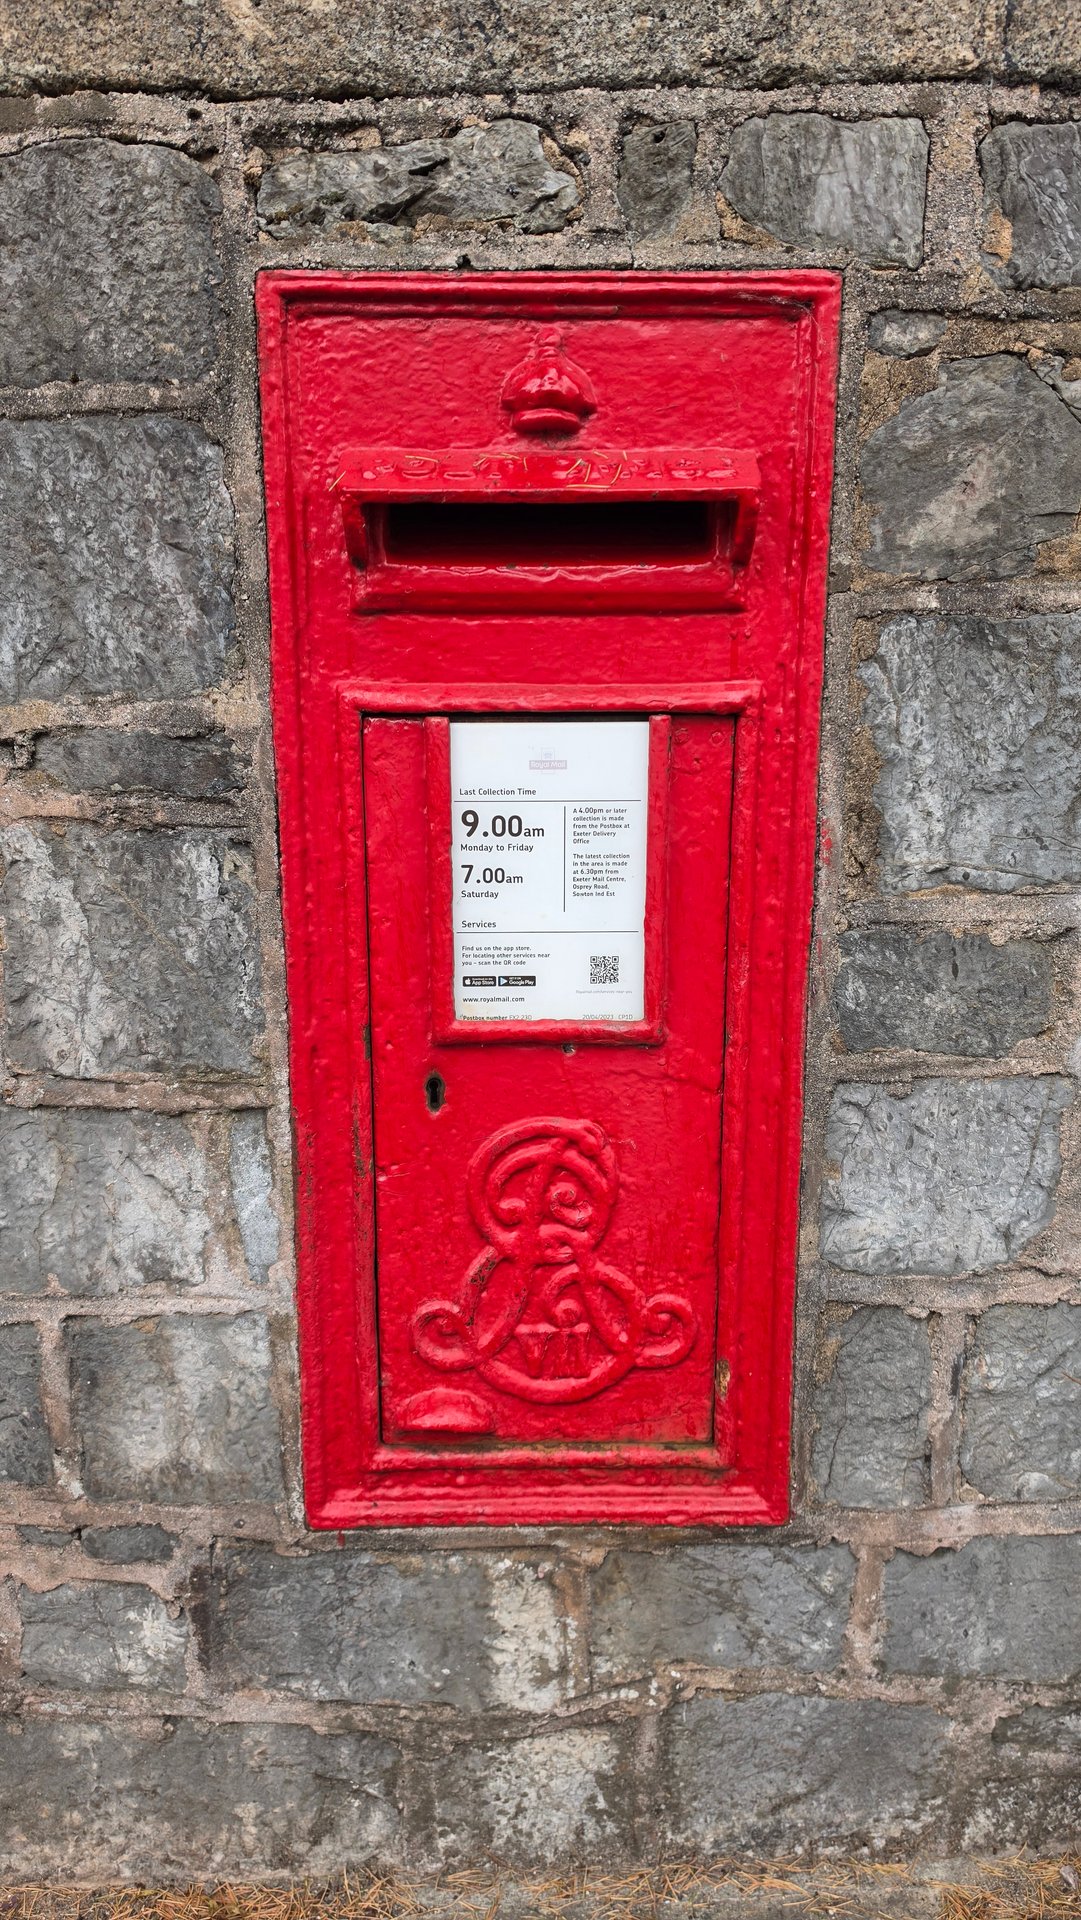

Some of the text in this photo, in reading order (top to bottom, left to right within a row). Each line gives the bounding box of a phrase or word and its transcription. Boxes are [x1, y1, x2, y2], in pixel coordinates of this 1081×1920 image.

[530, 761, 566, 769] Royal Mail
[459, 788, 537, 796] Last Collection Time
[579, 807, 604, 815] 4.00pm
[461, 809, 545, 838] 9.00am
[460, 844, 534, 854] Monday to Friday
[461, 865, 524, 884] 7.00am
[461, 890, 499, 900] Saturday
[461, 920, 497, 929] Services
[462, 996, 525, 1004] www.royalmail.com
